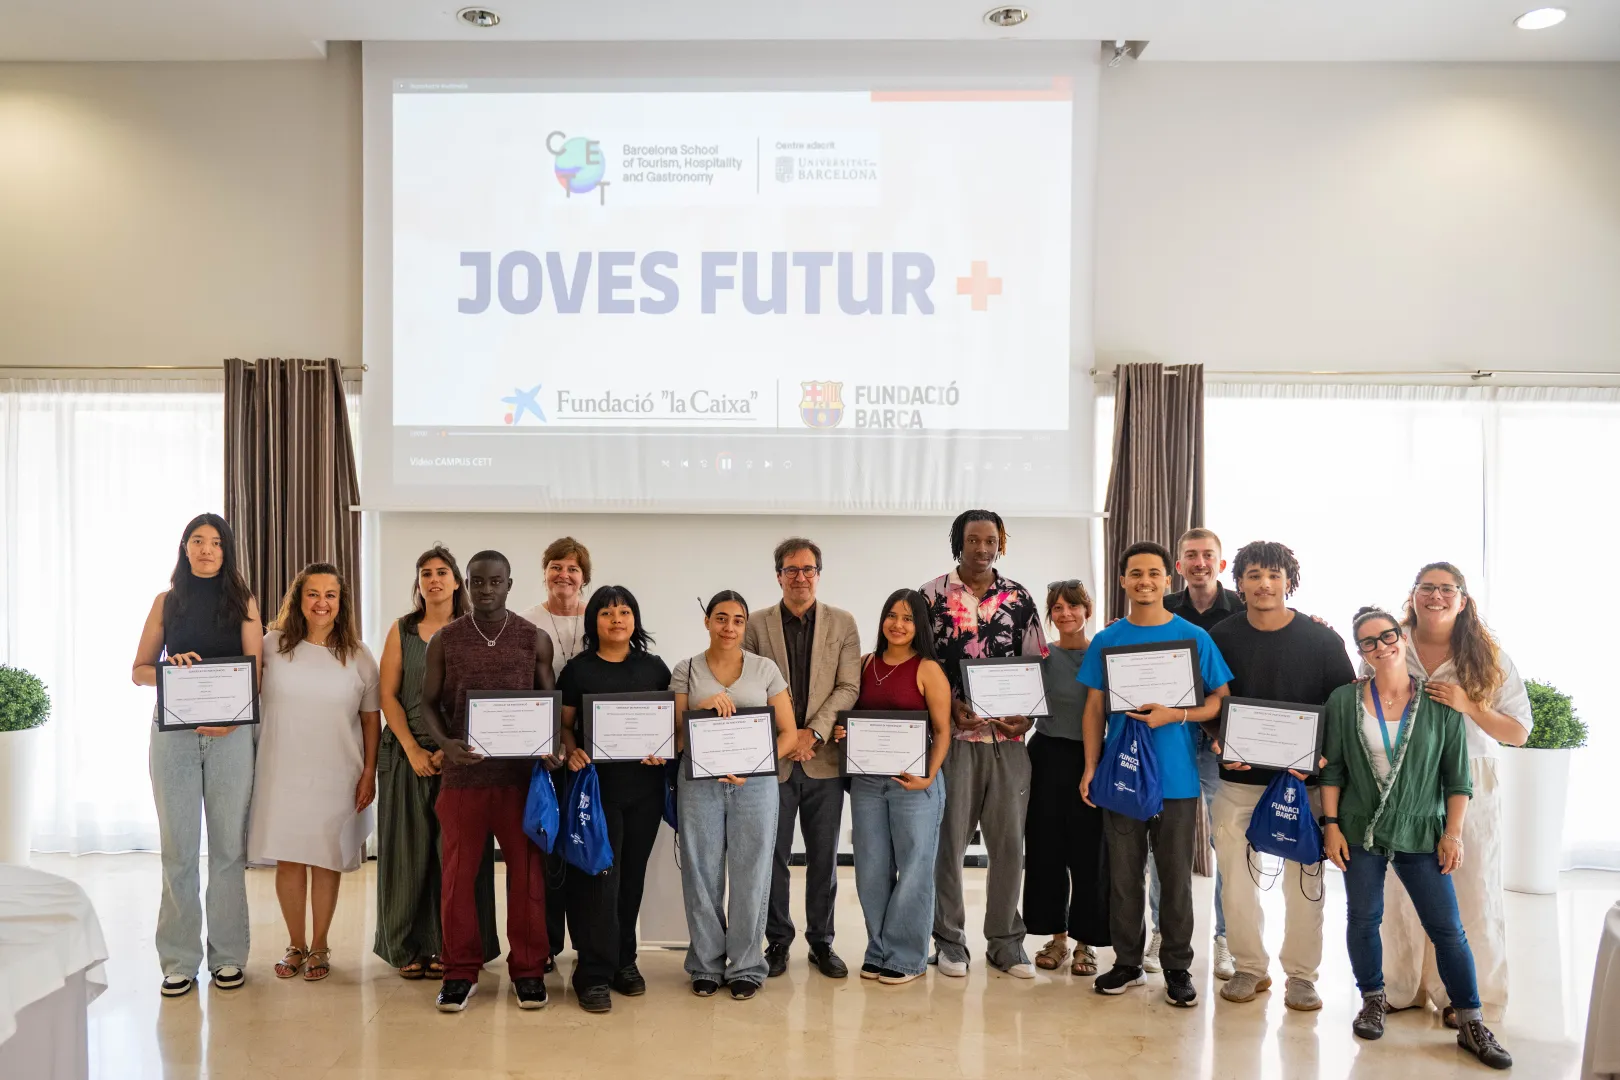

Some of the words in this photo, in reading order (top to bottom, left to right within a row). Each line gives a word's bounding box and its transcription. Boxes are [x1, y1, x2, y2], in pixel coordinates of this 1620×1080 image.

[622, 143, 678, 156] Barcelona
[680, 143, 719, 156] School
[622, 157, 634, 169] of
[636, 157, 682, 170] Tourism,
[684, 157, 743, 172] Hospitality
[622, 171, 643, 183] and
[646, 171, 714, 186] Gastronomy
[798, 169, 878, 181] BARCELONA
[457, 250, 680, 315] JOVES
[701, 251, 935, 315] FUTUR
[855, 380, 960, 406] FUNDACIÓ
[556, 390, 655, 414] Fundació
[435, 457, 471, 467] CAMPUS
[472, 457, 493, 467] CETT
